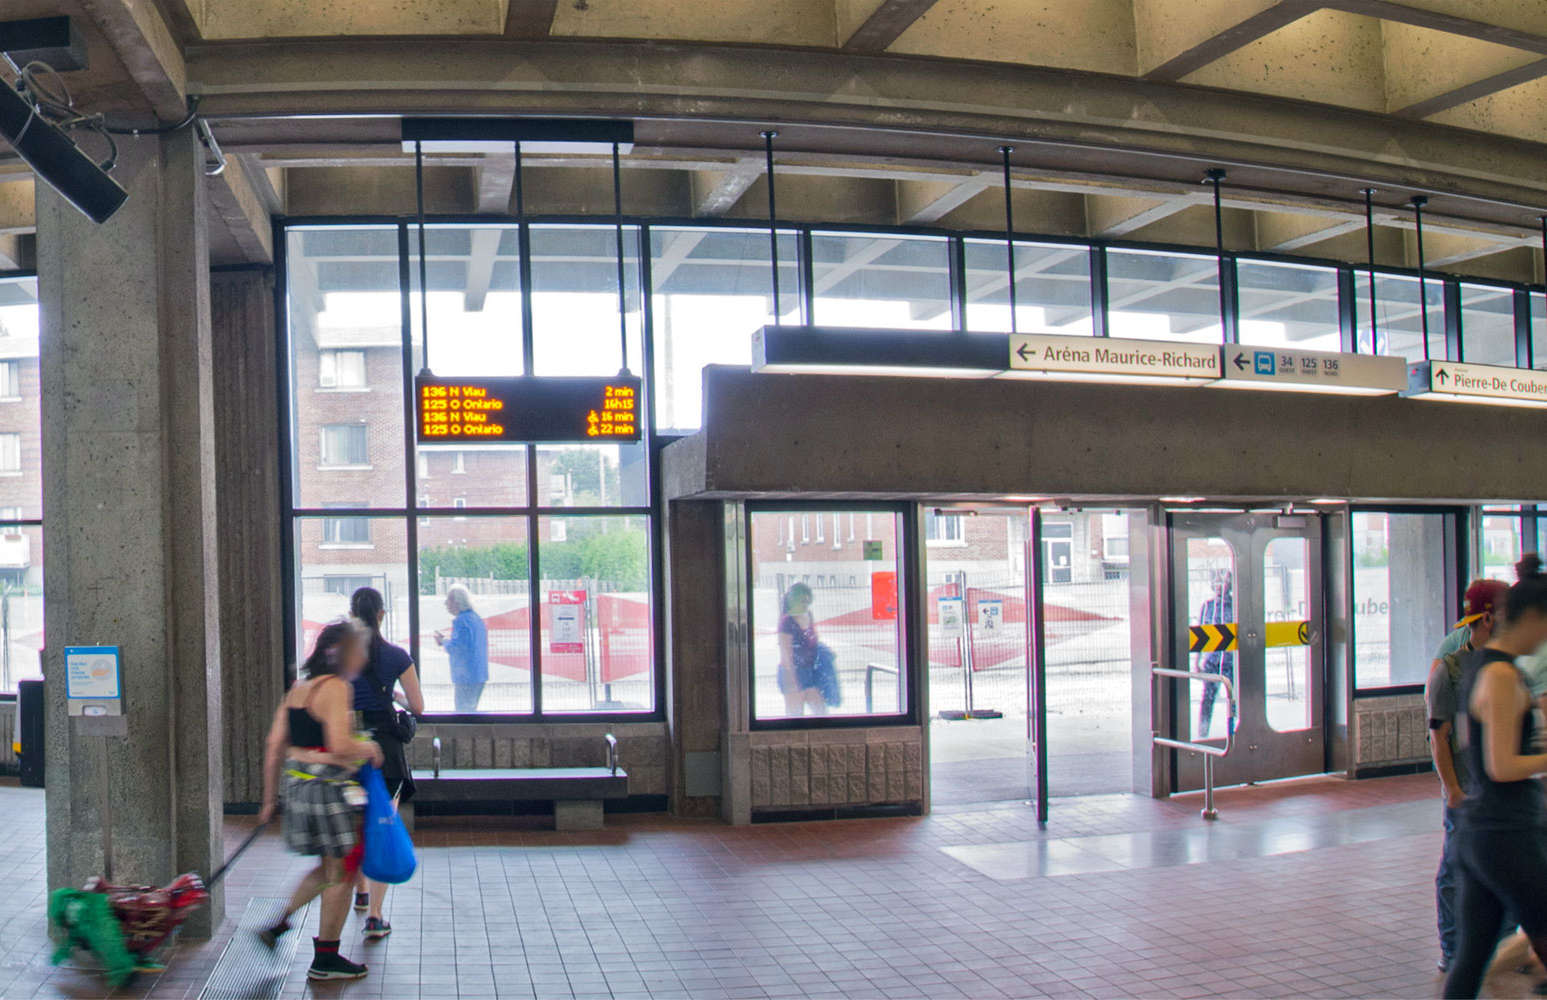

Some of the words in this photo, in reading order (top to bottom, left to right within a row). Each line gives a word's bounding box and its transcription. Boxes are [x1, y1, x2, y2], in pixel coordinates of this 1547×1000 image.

[1043, 345, 1090, 363] Aréna
[1095, 348, 1216, 370] Maurice-Richard
[1281, 356, 1293, 367] 34
[1301, 358, 1316, 370] 125
[1323, 360, 1338, 371] 136
[1454, 374, 1507, 391] Pierre-De
[423, 387, 446, 397] 136
[450, 387, 459, 397] N
[463, 387, 486, 397] Viau
[605, 387, 612, 397] 2
[615, 387, 634, 397] min
[423, 399, 447, 409] 125
[463, 399, 503, 409] Ontario
[604, 400, 634, 409] 16h15
[424, 412, 447, 422] 136
[450, 412, 459, 422] N
[463, 412, 486, 422] Viau
[601, 412, 612, 422] 16
[615, 412, 634, 422] min
[424, 424, 448, 435] 125
[463, 424, 503, 435] Ontario
[600, 424, 612, 434] 22
[615, 424, 634, 434] min
